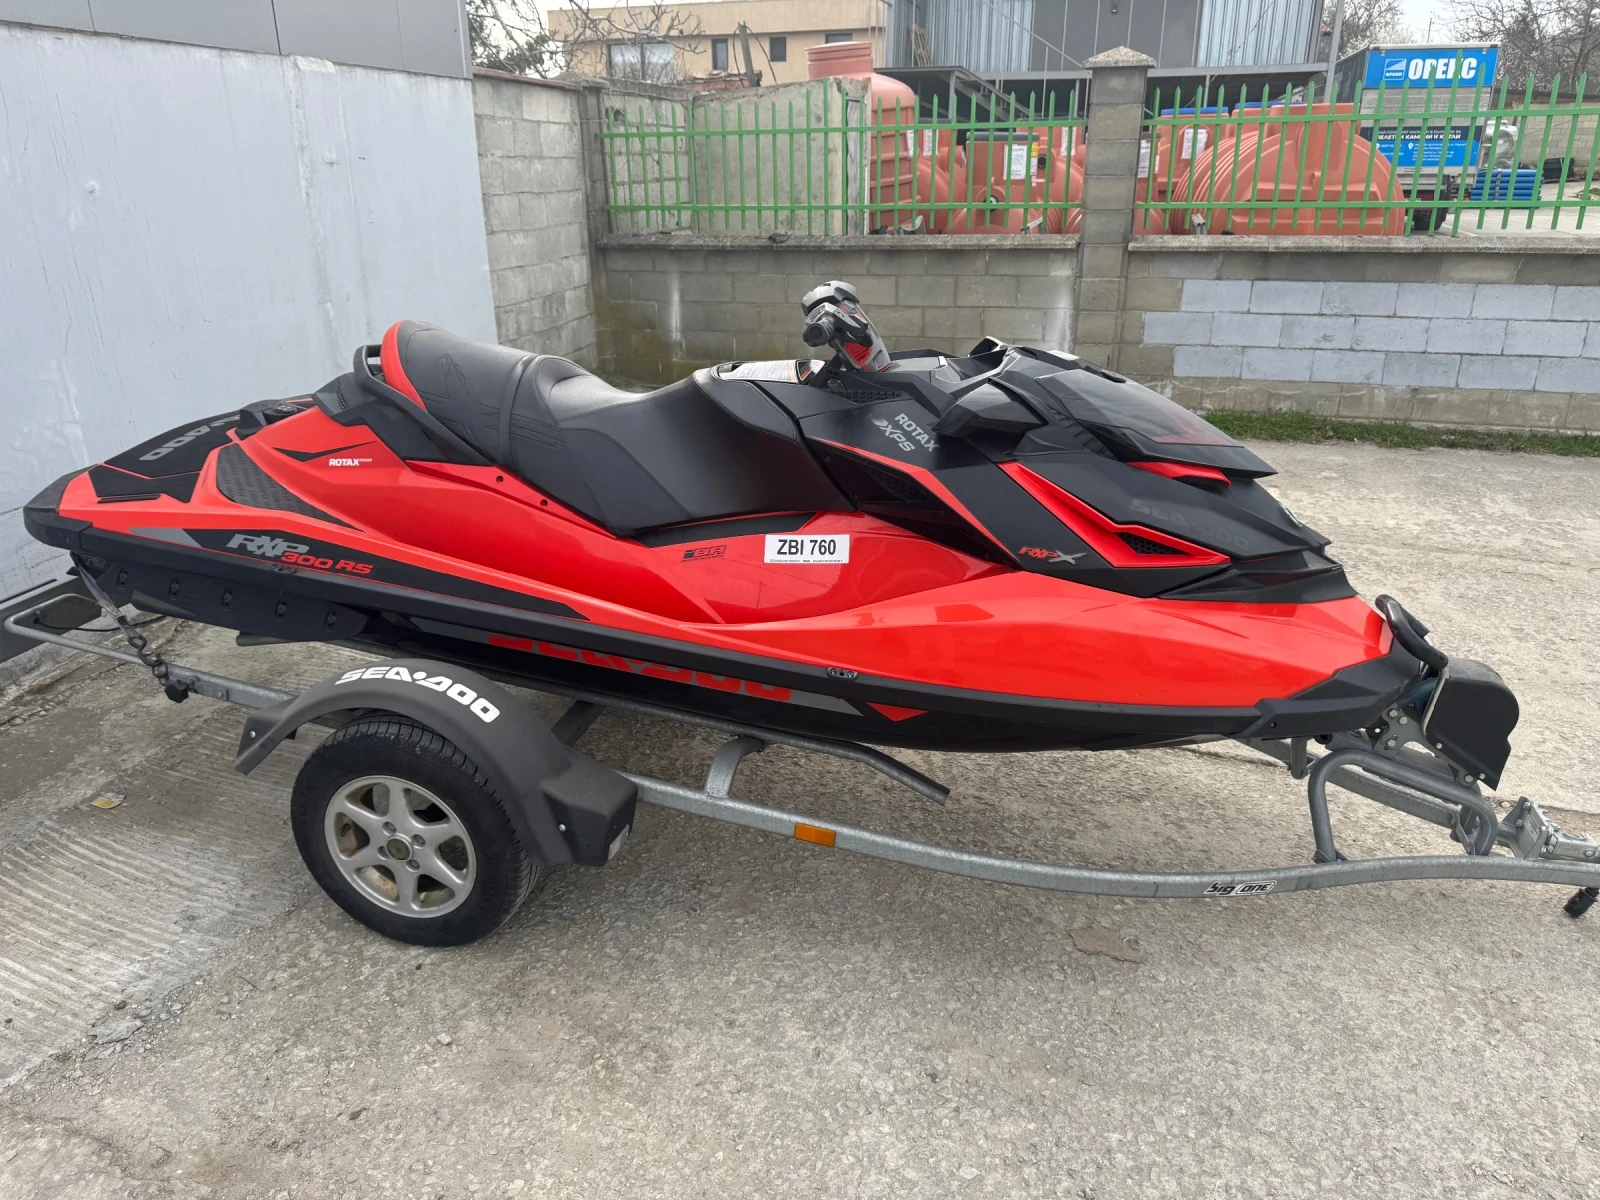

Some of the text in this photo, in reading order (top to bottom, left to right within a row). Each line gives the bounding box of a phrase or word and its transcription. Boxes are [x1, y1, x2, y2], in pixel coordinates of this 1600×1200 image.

[879, 424, 916, 452] XPS
[894, 413, 939, 452] ROTAX
[329, 458, 360, 467] ROTAX
[226, 533, 310, 558] RXP
[777, 539, 837, 556] ZBI 760
[281, 551, 374, 575] 300 RS
